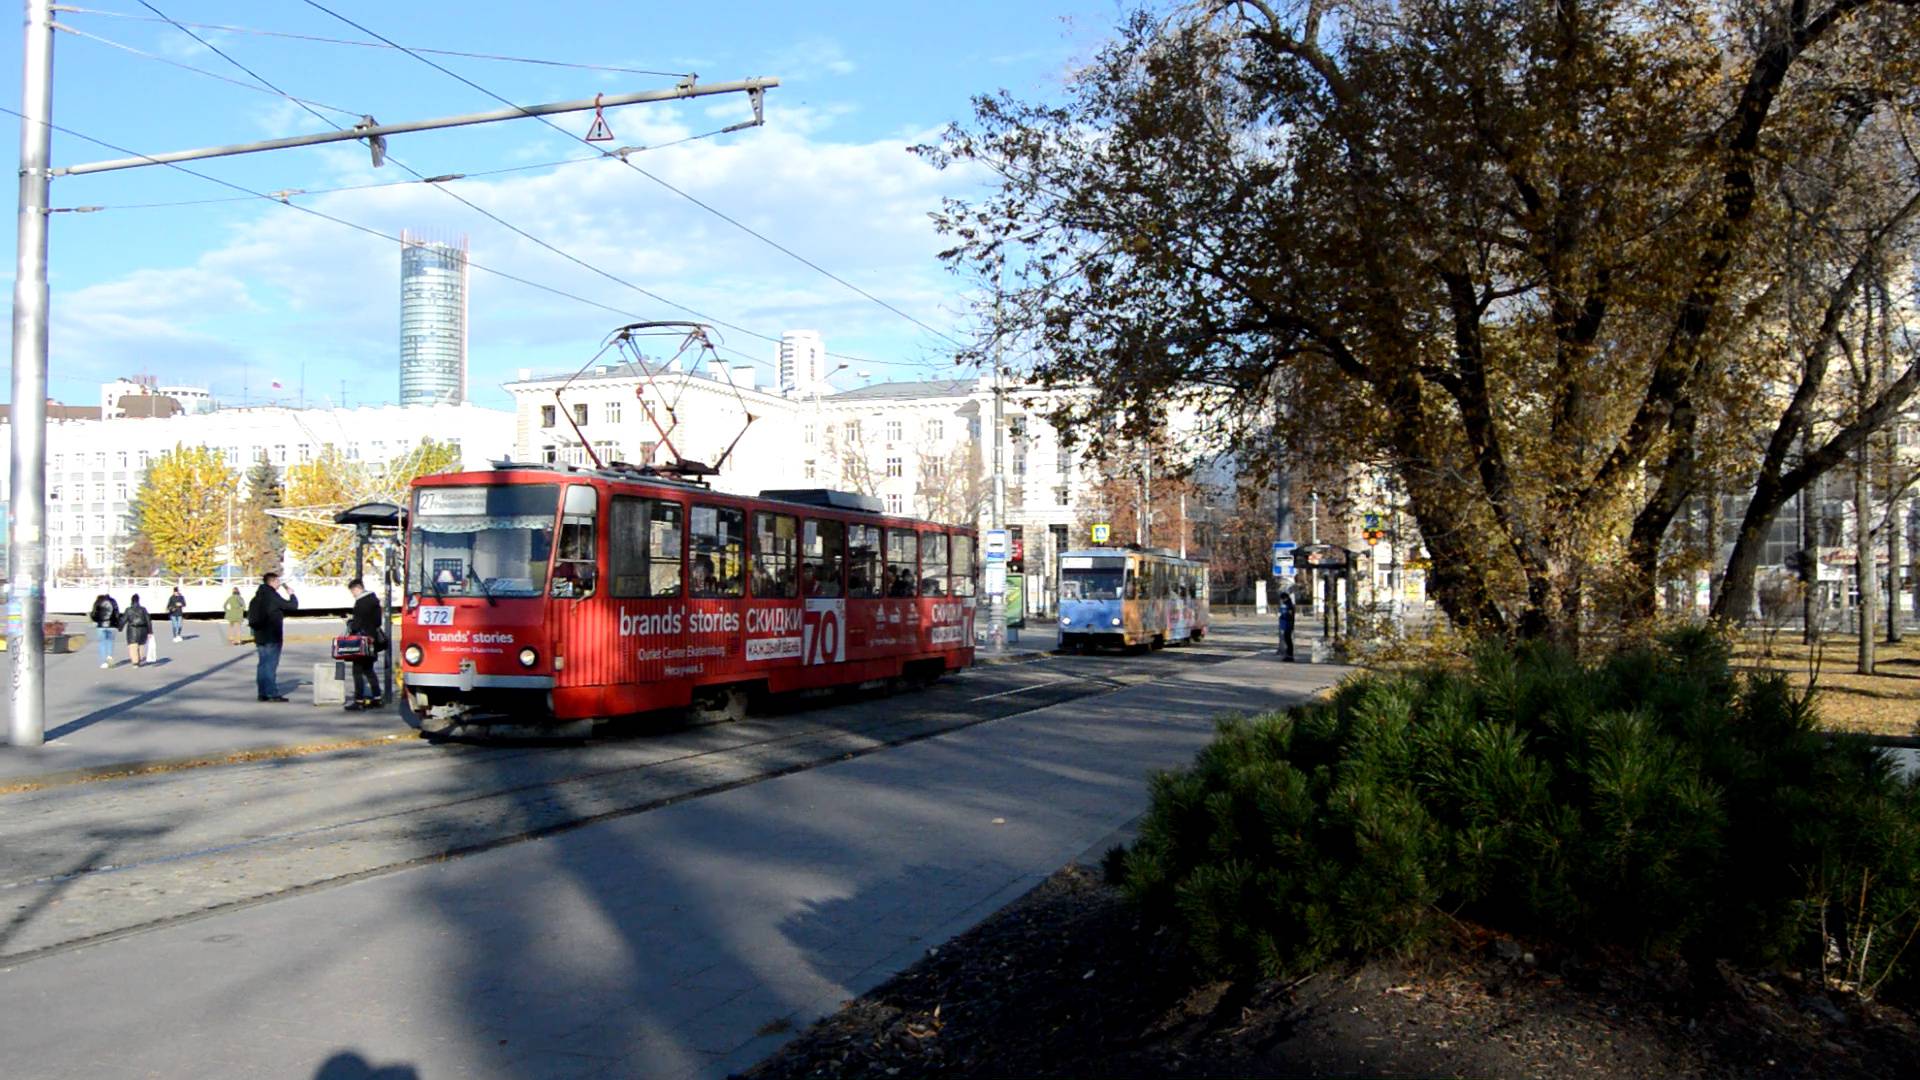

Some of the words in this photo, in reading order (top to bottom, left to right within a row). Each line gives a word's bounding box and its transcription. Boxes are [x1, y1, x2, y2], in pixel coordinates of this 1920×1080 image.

[420, 493, 435, 509] 27
[424, 610, 448, 624] 372
[619, 605, 685, 636] brands'
[689, 606, 739, 633] stories
[746, 607, 802, 636] СКИДКИ
[428, 629, 470, 642] brands'
[472, 631, 514, 643] stories
[803, 610, 839, 665] 70
